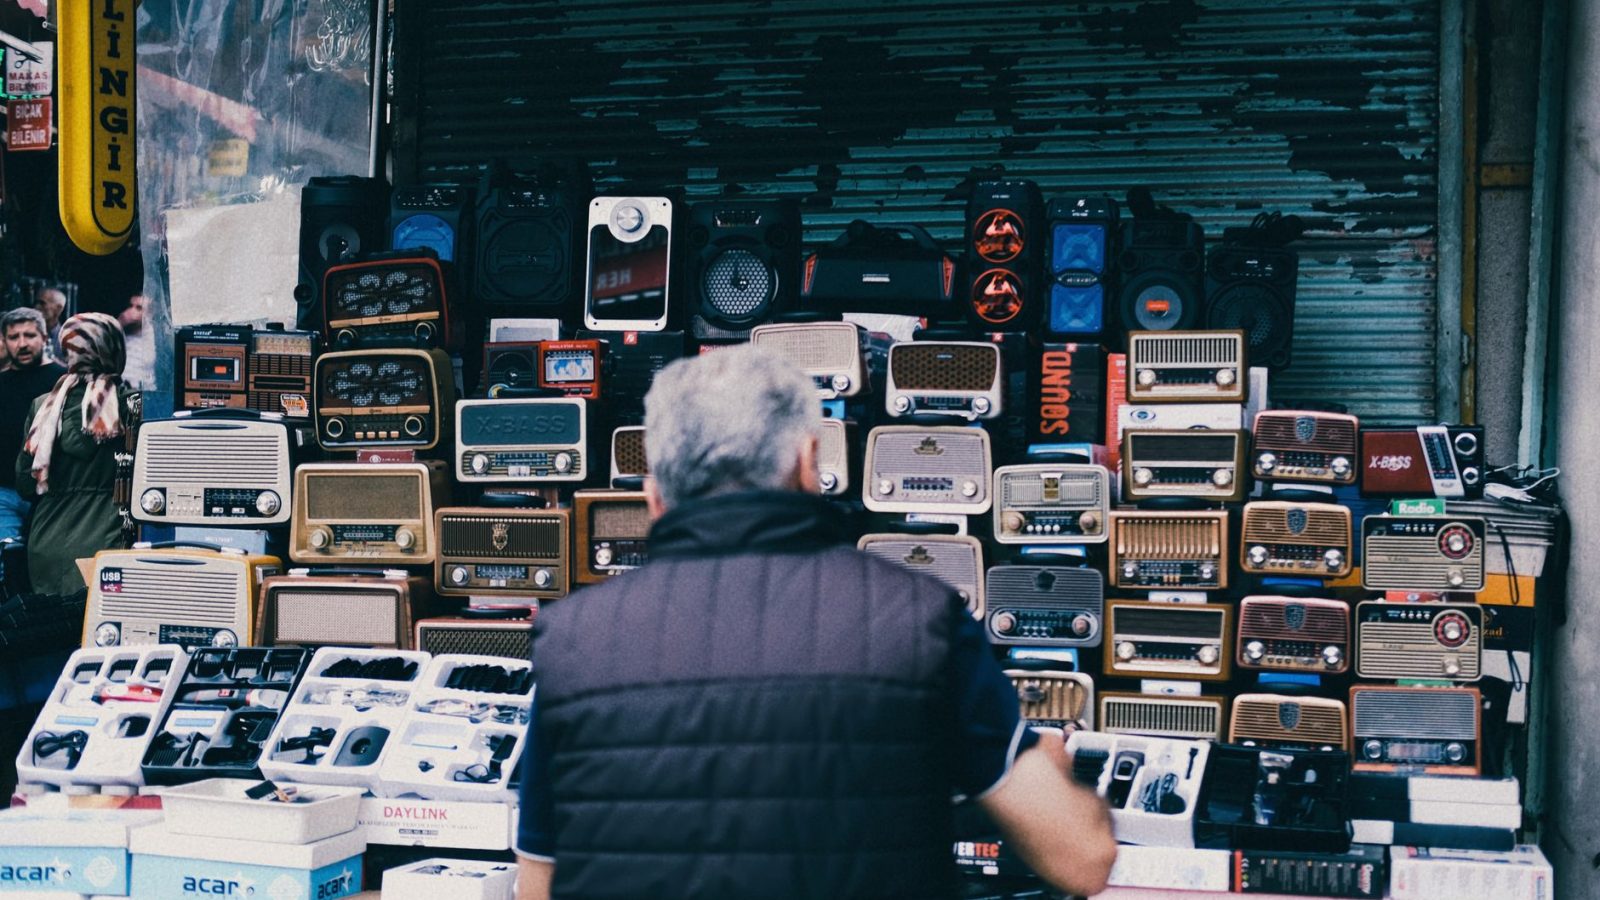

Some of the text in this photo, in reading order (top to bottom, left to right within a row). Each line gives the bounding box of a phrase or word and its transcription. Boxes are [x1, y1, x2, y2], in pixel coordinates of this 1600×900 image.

[9, 71, 48, 80] MAKAS
[100, 0, 128, 209] LİNGİR
[1040, 351, 1071, 435] SOUND
[478, 415, 565, 434] X-BASS
[1368, 455, 1412, 470] X-BASS
[1398, 502, 1436, 514] Radio
[102, 571, 120, 582] USB
[384, 806, 448, 820] DAYLINK
[953, 841, 999, 857] ERTEC
[0, 865, 56, 881] acar
[183, 876, 239, 895] acar
[317, 876, 346, 900] acar
